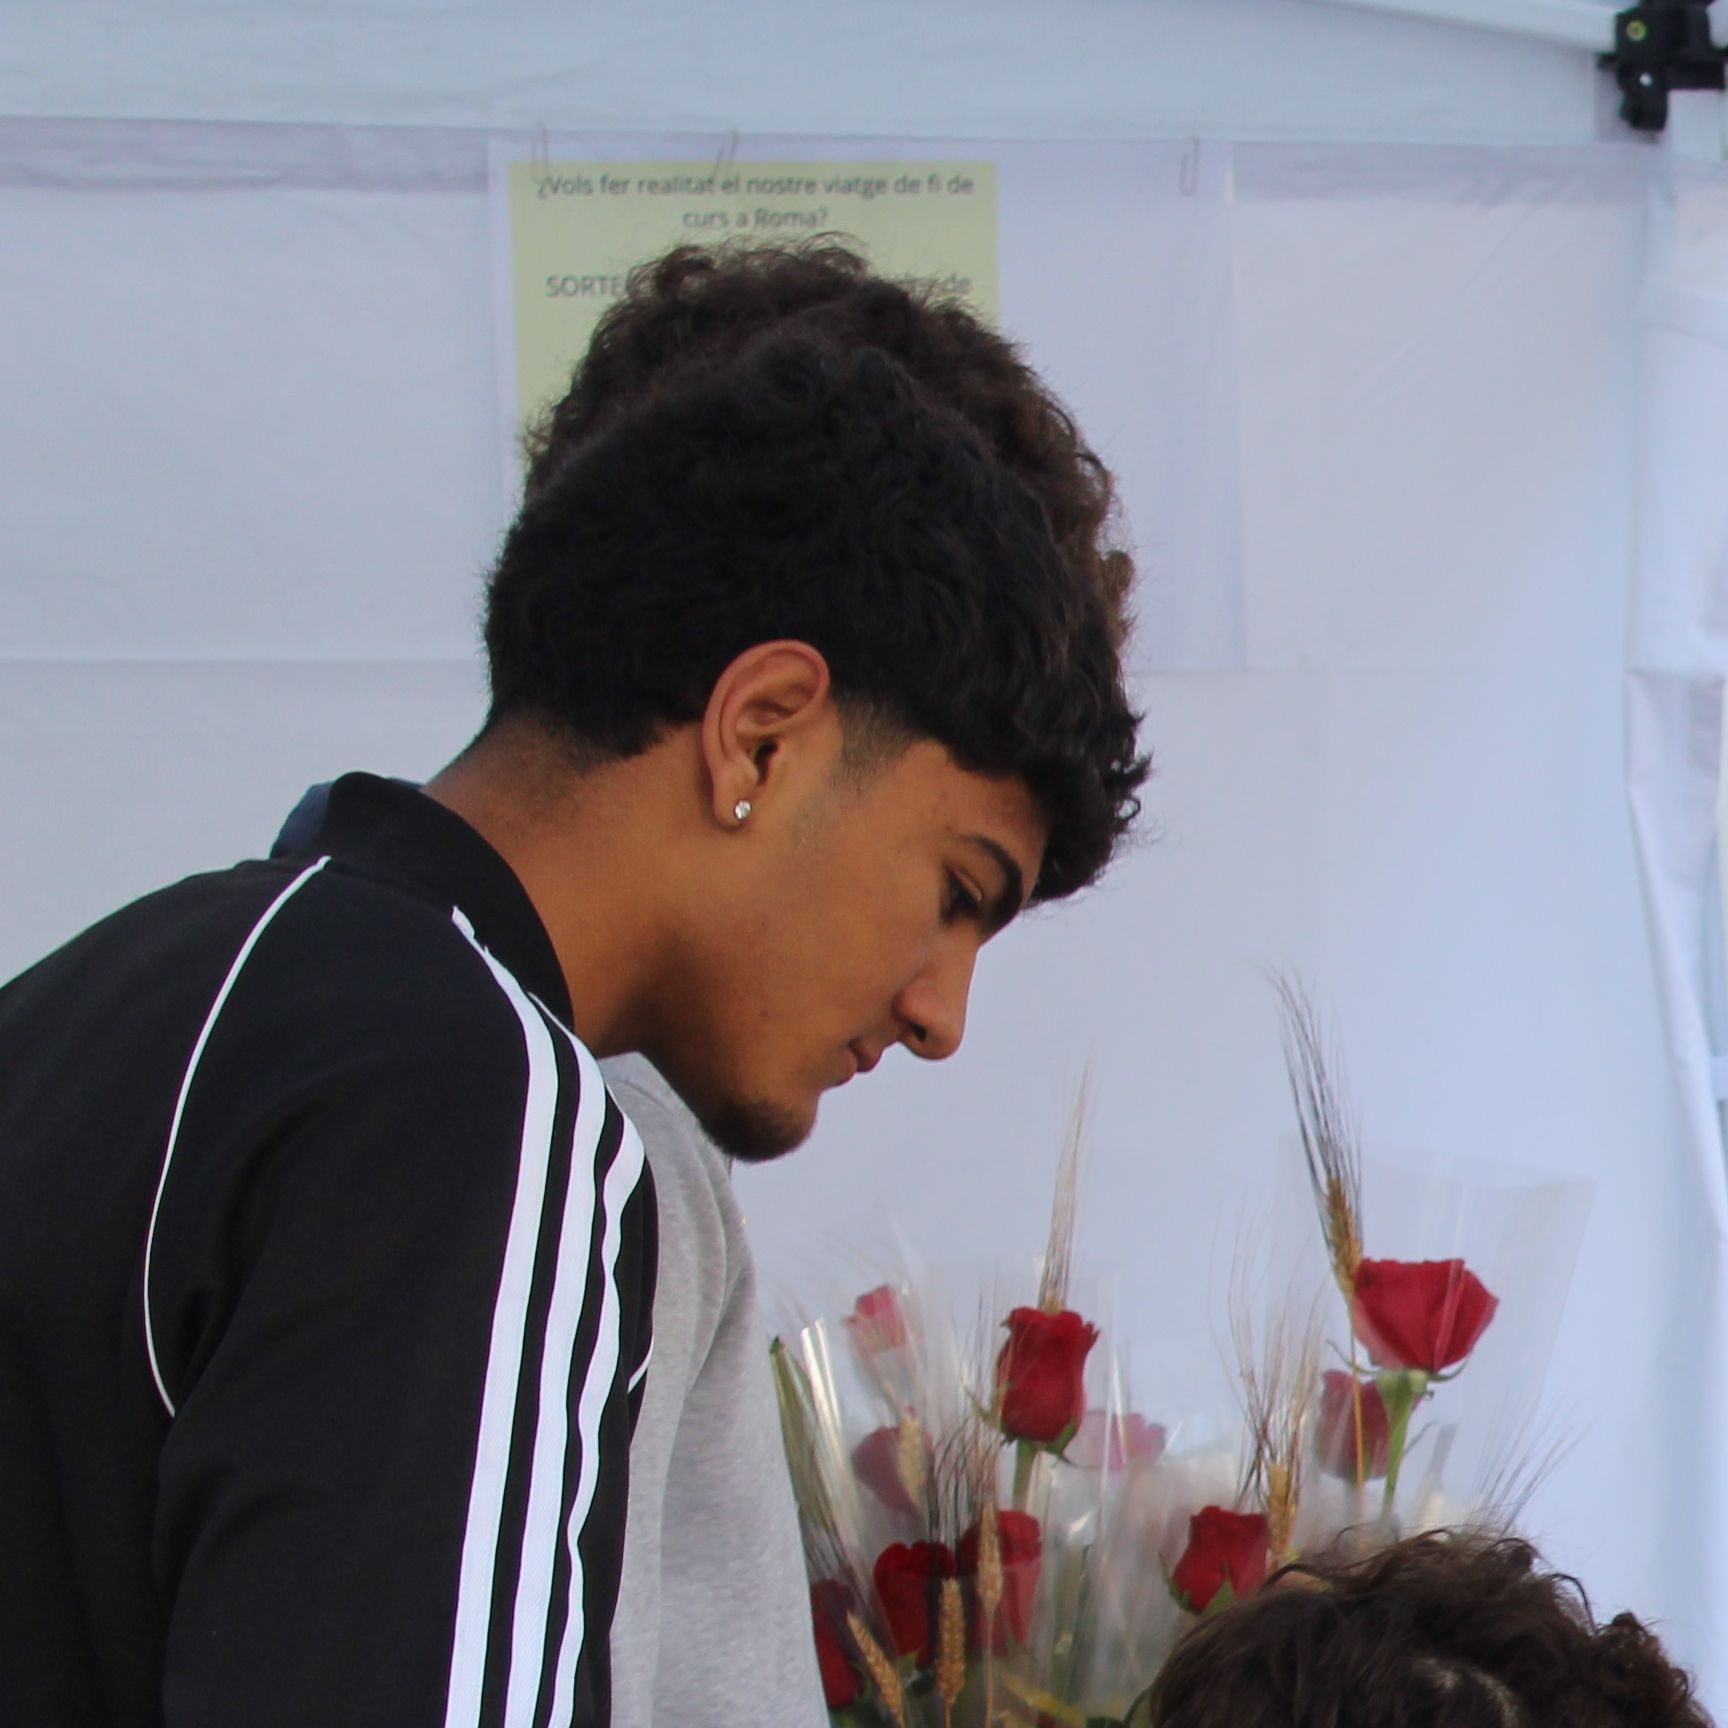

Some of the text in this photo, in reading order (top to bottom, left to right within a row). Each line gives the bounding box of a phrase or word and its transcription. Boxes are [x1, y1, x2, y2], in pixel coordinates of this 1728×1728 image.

[537, 173, 974, 200] ¿Vols fer realitat el nostre viatge de fi de
[683, 208, 828, 229] curs a Roma?
[546, 275, 628, 299] SORTE
